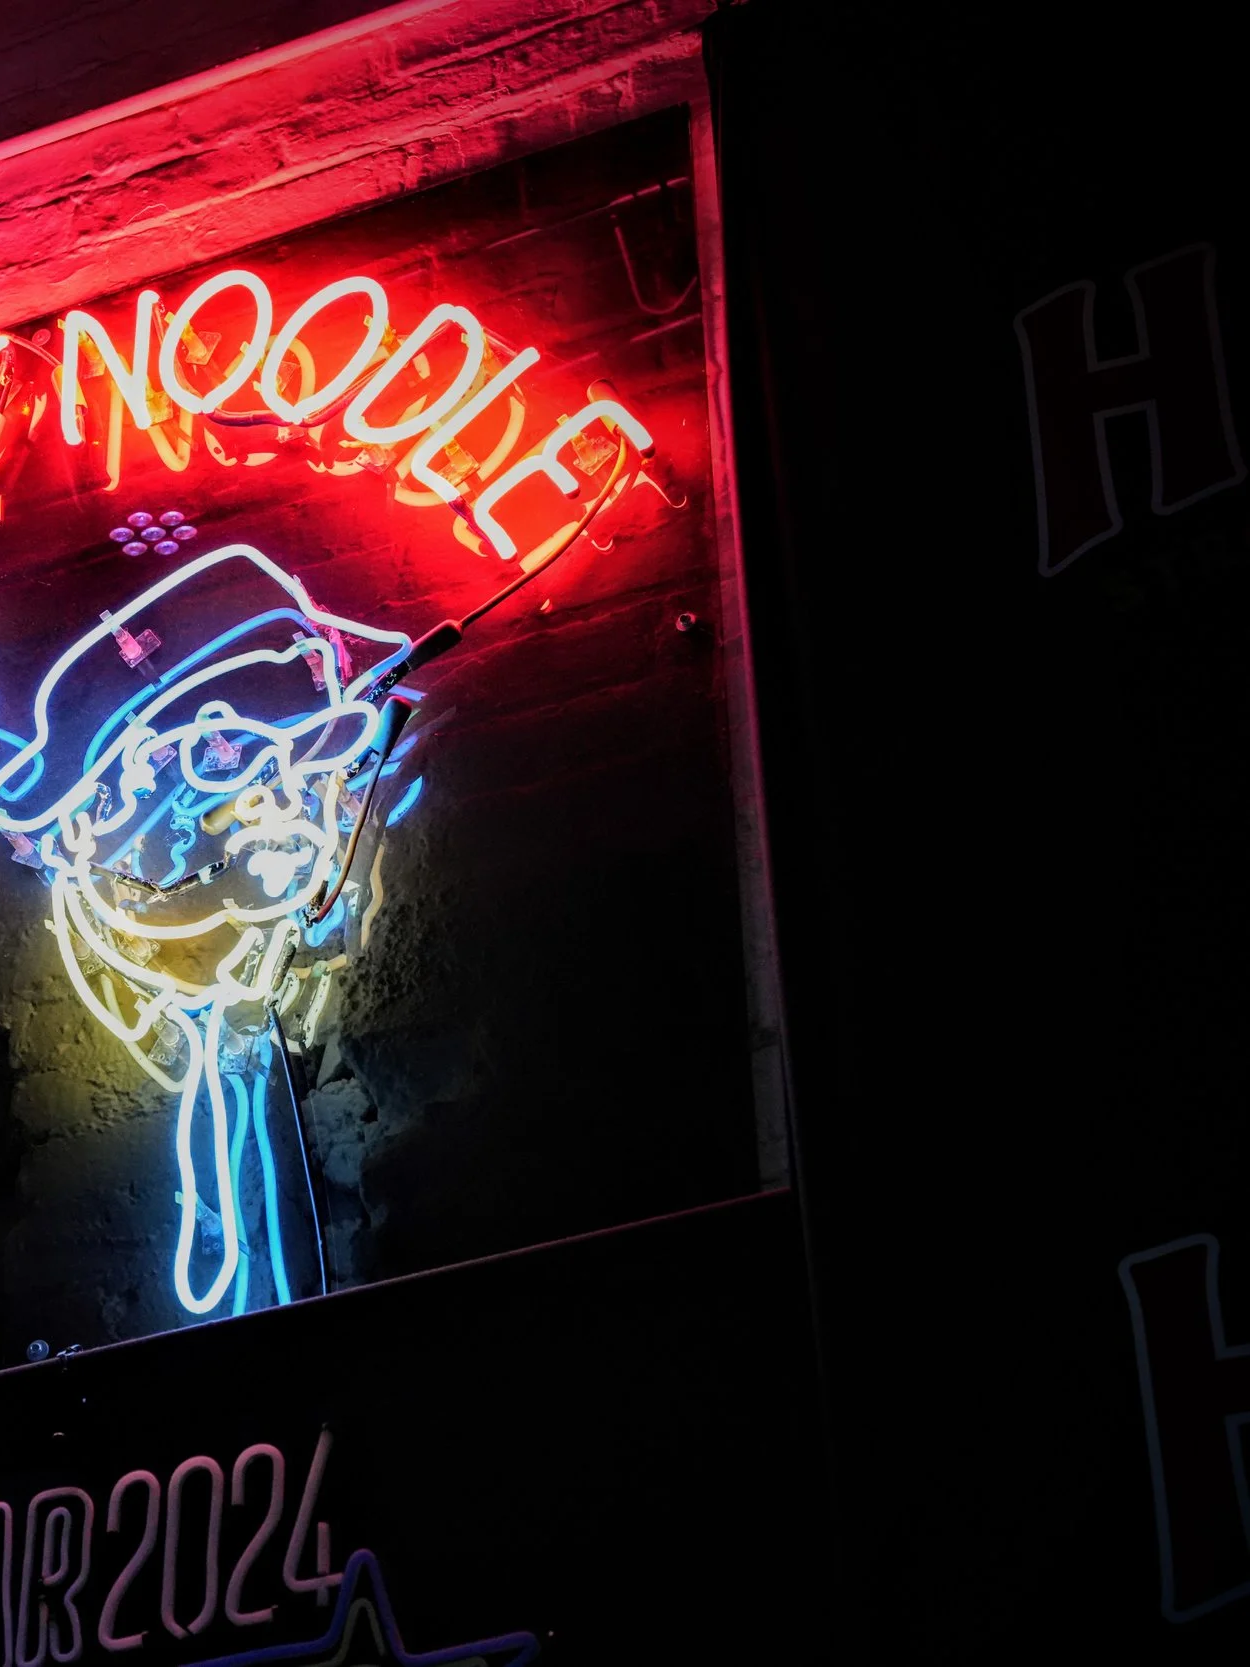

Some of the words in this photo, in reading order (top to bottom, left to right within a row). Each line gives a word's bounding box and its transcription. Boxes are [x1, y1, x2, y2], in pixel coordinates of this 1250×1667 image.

[60, 269, 654, 561] NOODLE
[1012, 240, 1249, 579] H
[98, 1424, 346, 1653] 2024
